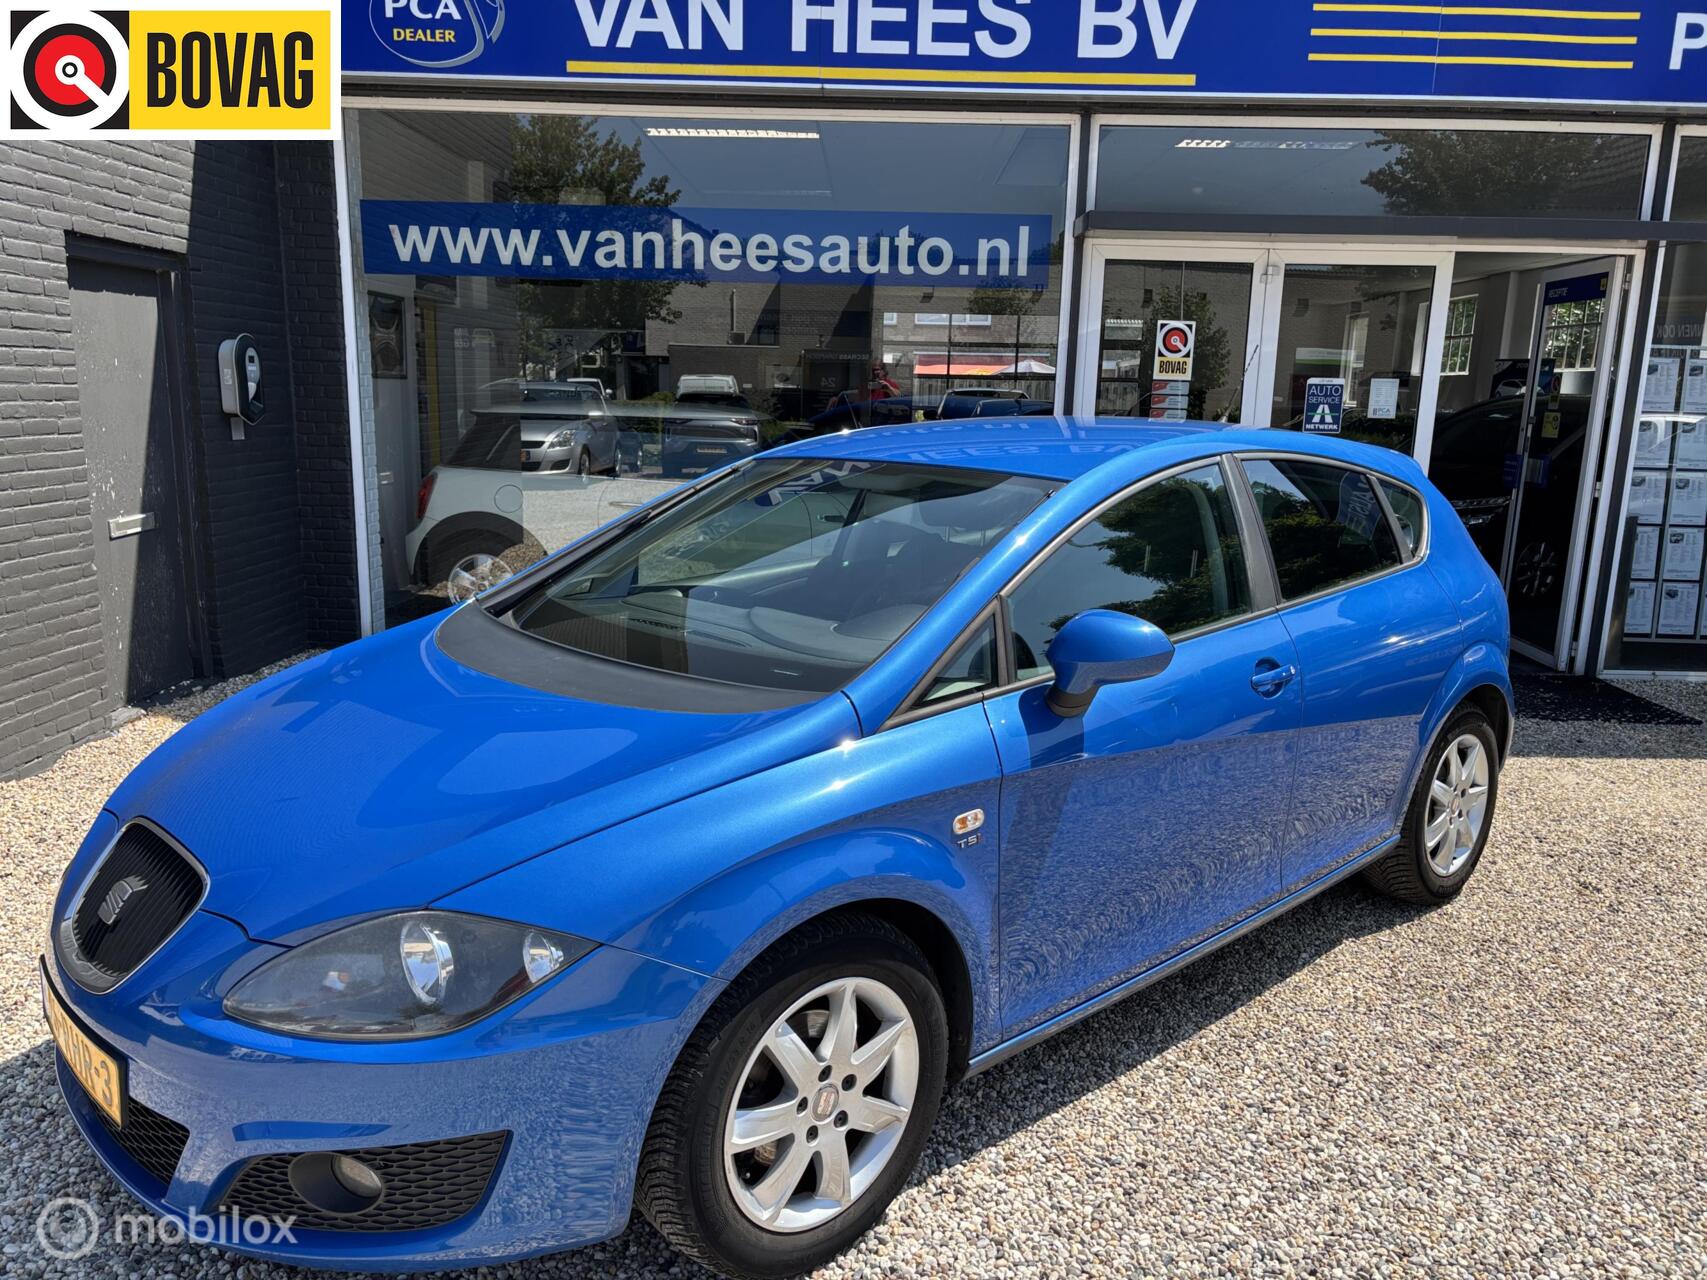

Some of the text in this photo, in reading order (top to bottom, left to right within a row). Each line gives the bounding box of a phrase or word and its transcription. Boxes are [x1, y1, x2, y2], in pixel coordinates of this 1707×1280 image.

[385, 0, 462, 20] PCA
[393, 28, 456, 42] DEALER
[571, 0, 1197, 60] VAN HEES BV
[388, 219, 1030, 277] www.vanheesauto.nl
[1159, 360, 1188, 374] BOVAG
[1309, 385, 1342, 396] AUTO
[1308, 396, 1340, 404] SERVICE
